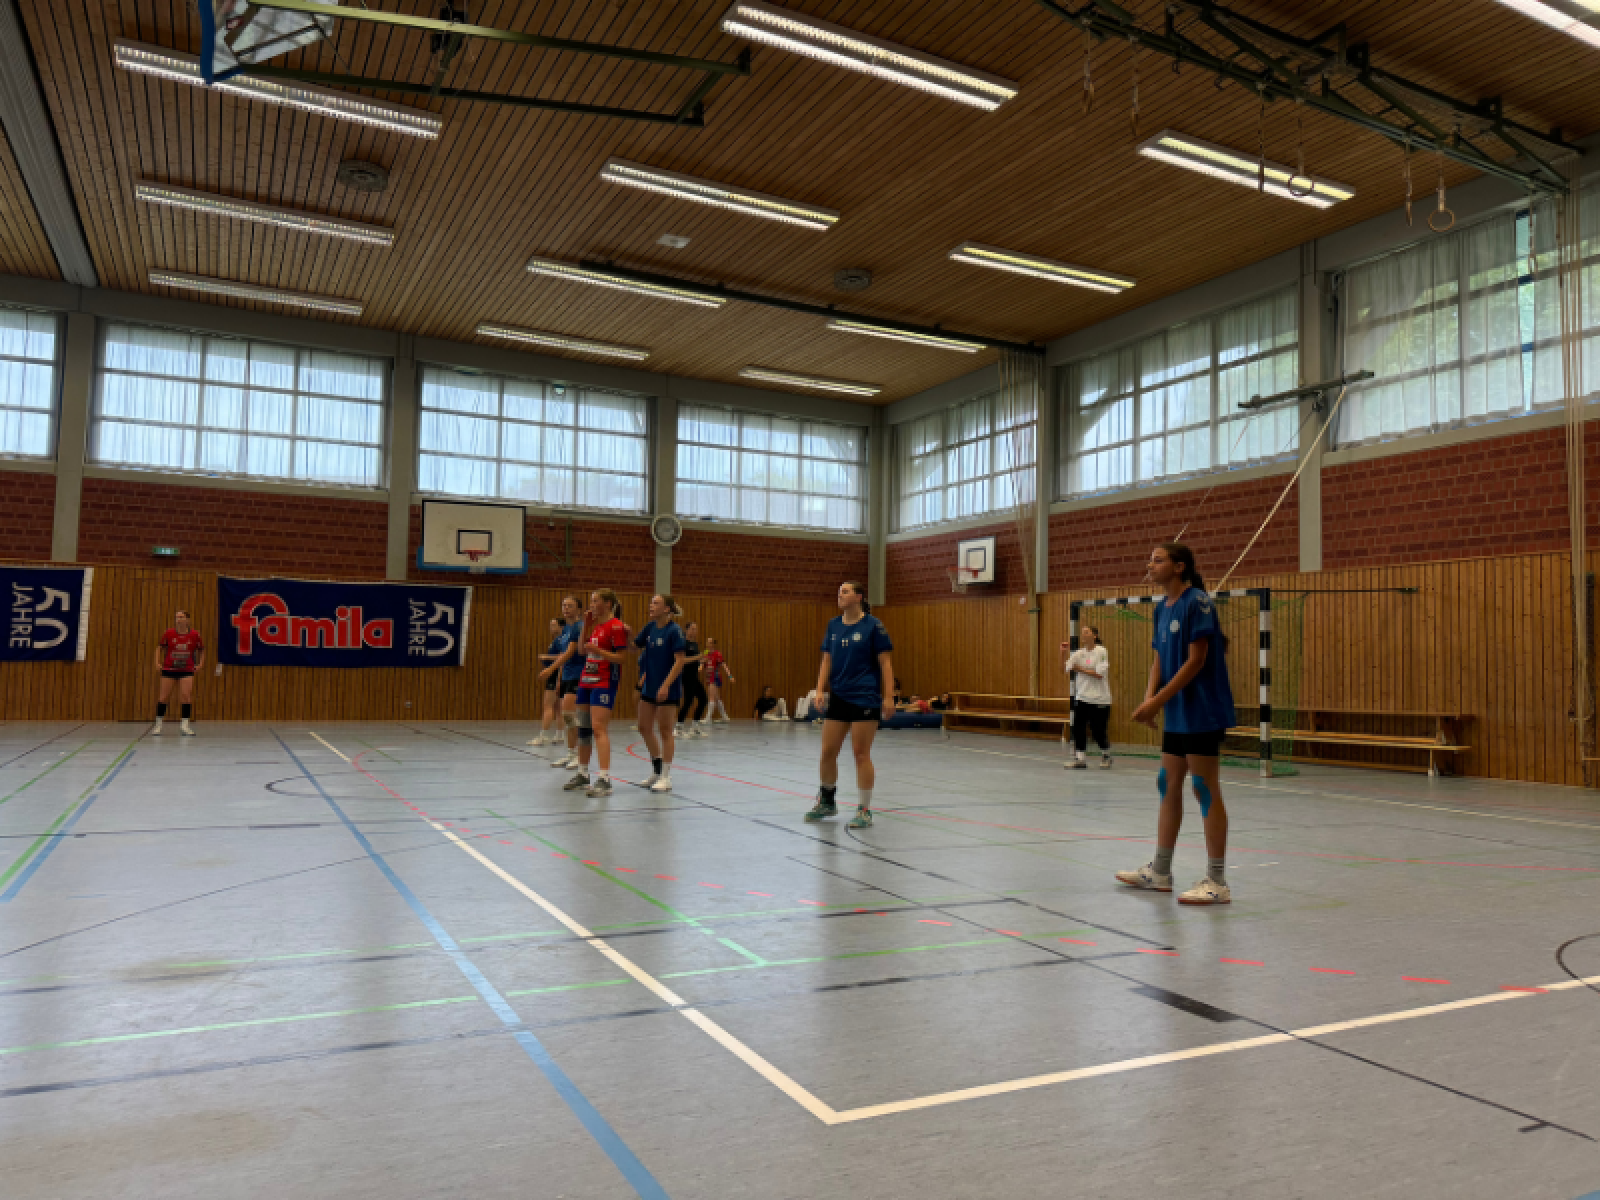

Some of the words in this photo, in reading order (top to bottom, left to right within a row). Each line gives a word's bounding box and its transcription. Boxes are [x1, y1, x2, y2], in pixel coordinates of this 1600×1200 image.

[9, 582, 34, 649] JAHRE
[33, 586, 70, 650] 50
[230, 592, 394, 656] famila
[408, 597, 427, 657] JAHRE
[427, 601, 455, 657] 50
